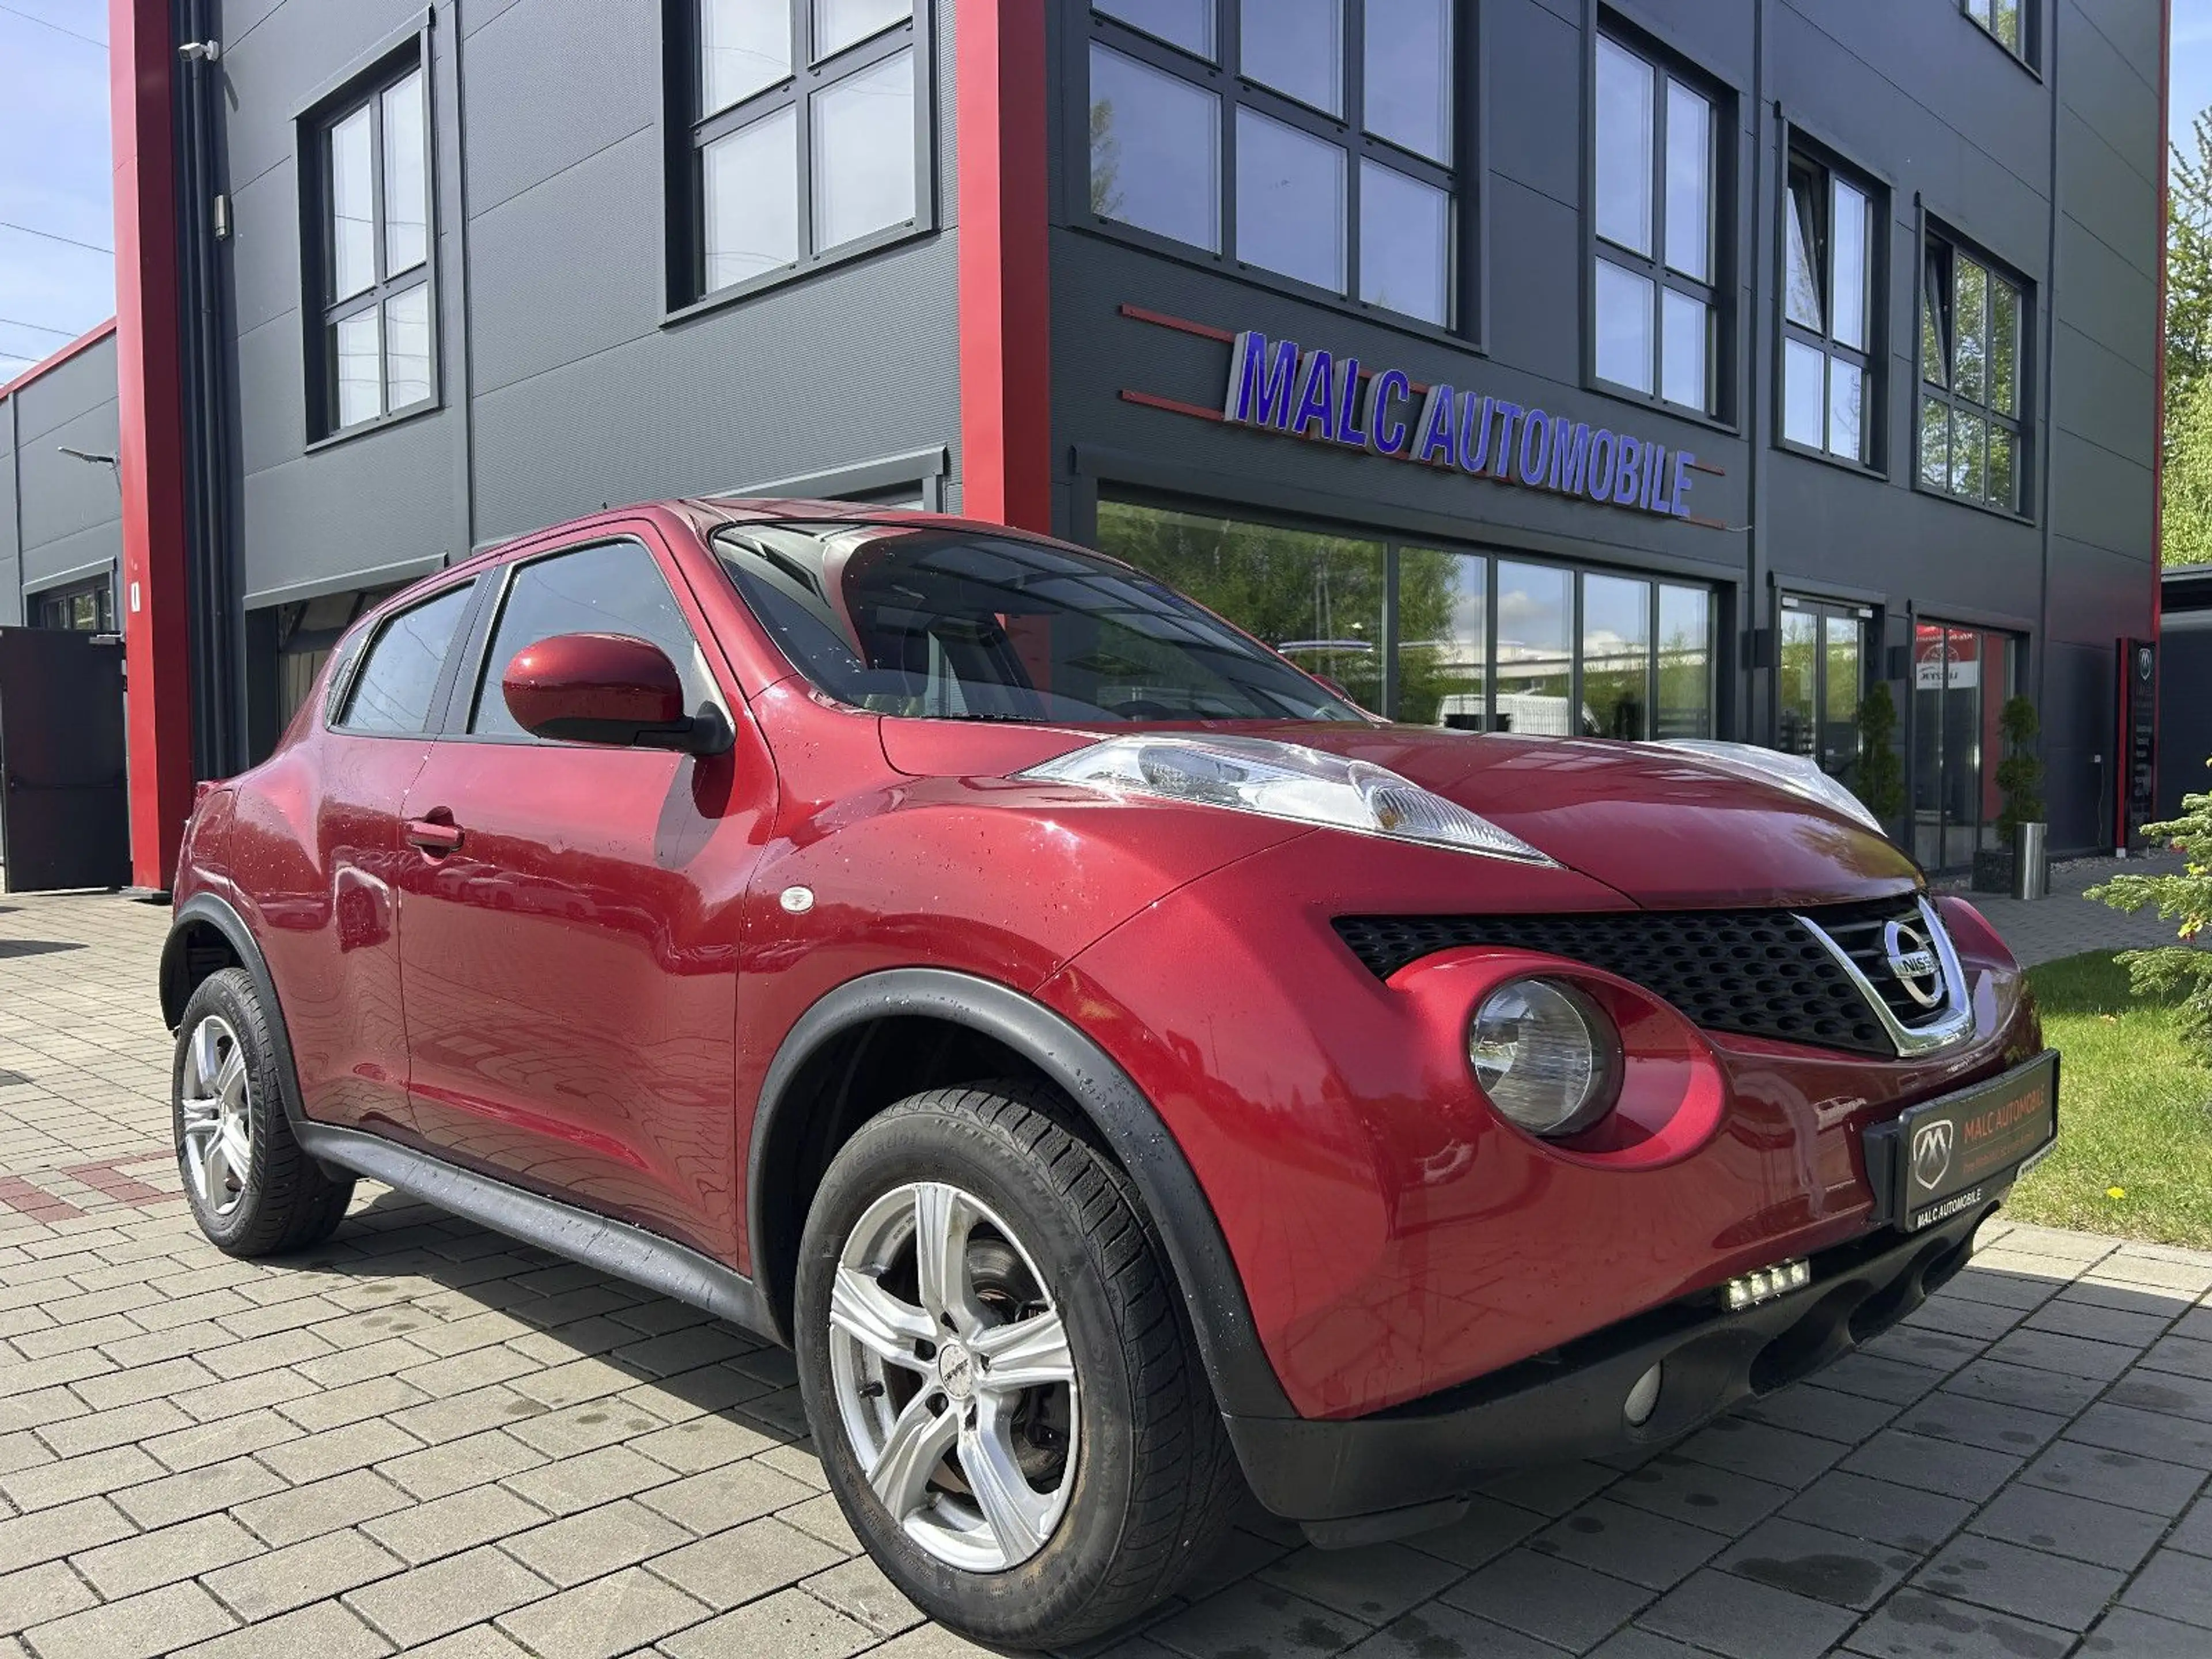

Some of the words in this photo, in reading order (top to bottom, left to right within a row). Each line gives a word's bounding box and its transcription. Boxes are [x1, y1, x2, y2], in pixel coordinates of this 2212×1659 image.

[1235, 330, 1410, 456] MALC
[1419, 384, 1696, 518] AUTOMOBILE
[1964, 1111, 1994, 1144] MALC
[1996, 1085, 2046, 1130] AUTOMOBILE
[1918, 1208, 1938, 1229] MALC
[1938, 1188, 1982, 1219] AUTOMOBILE
